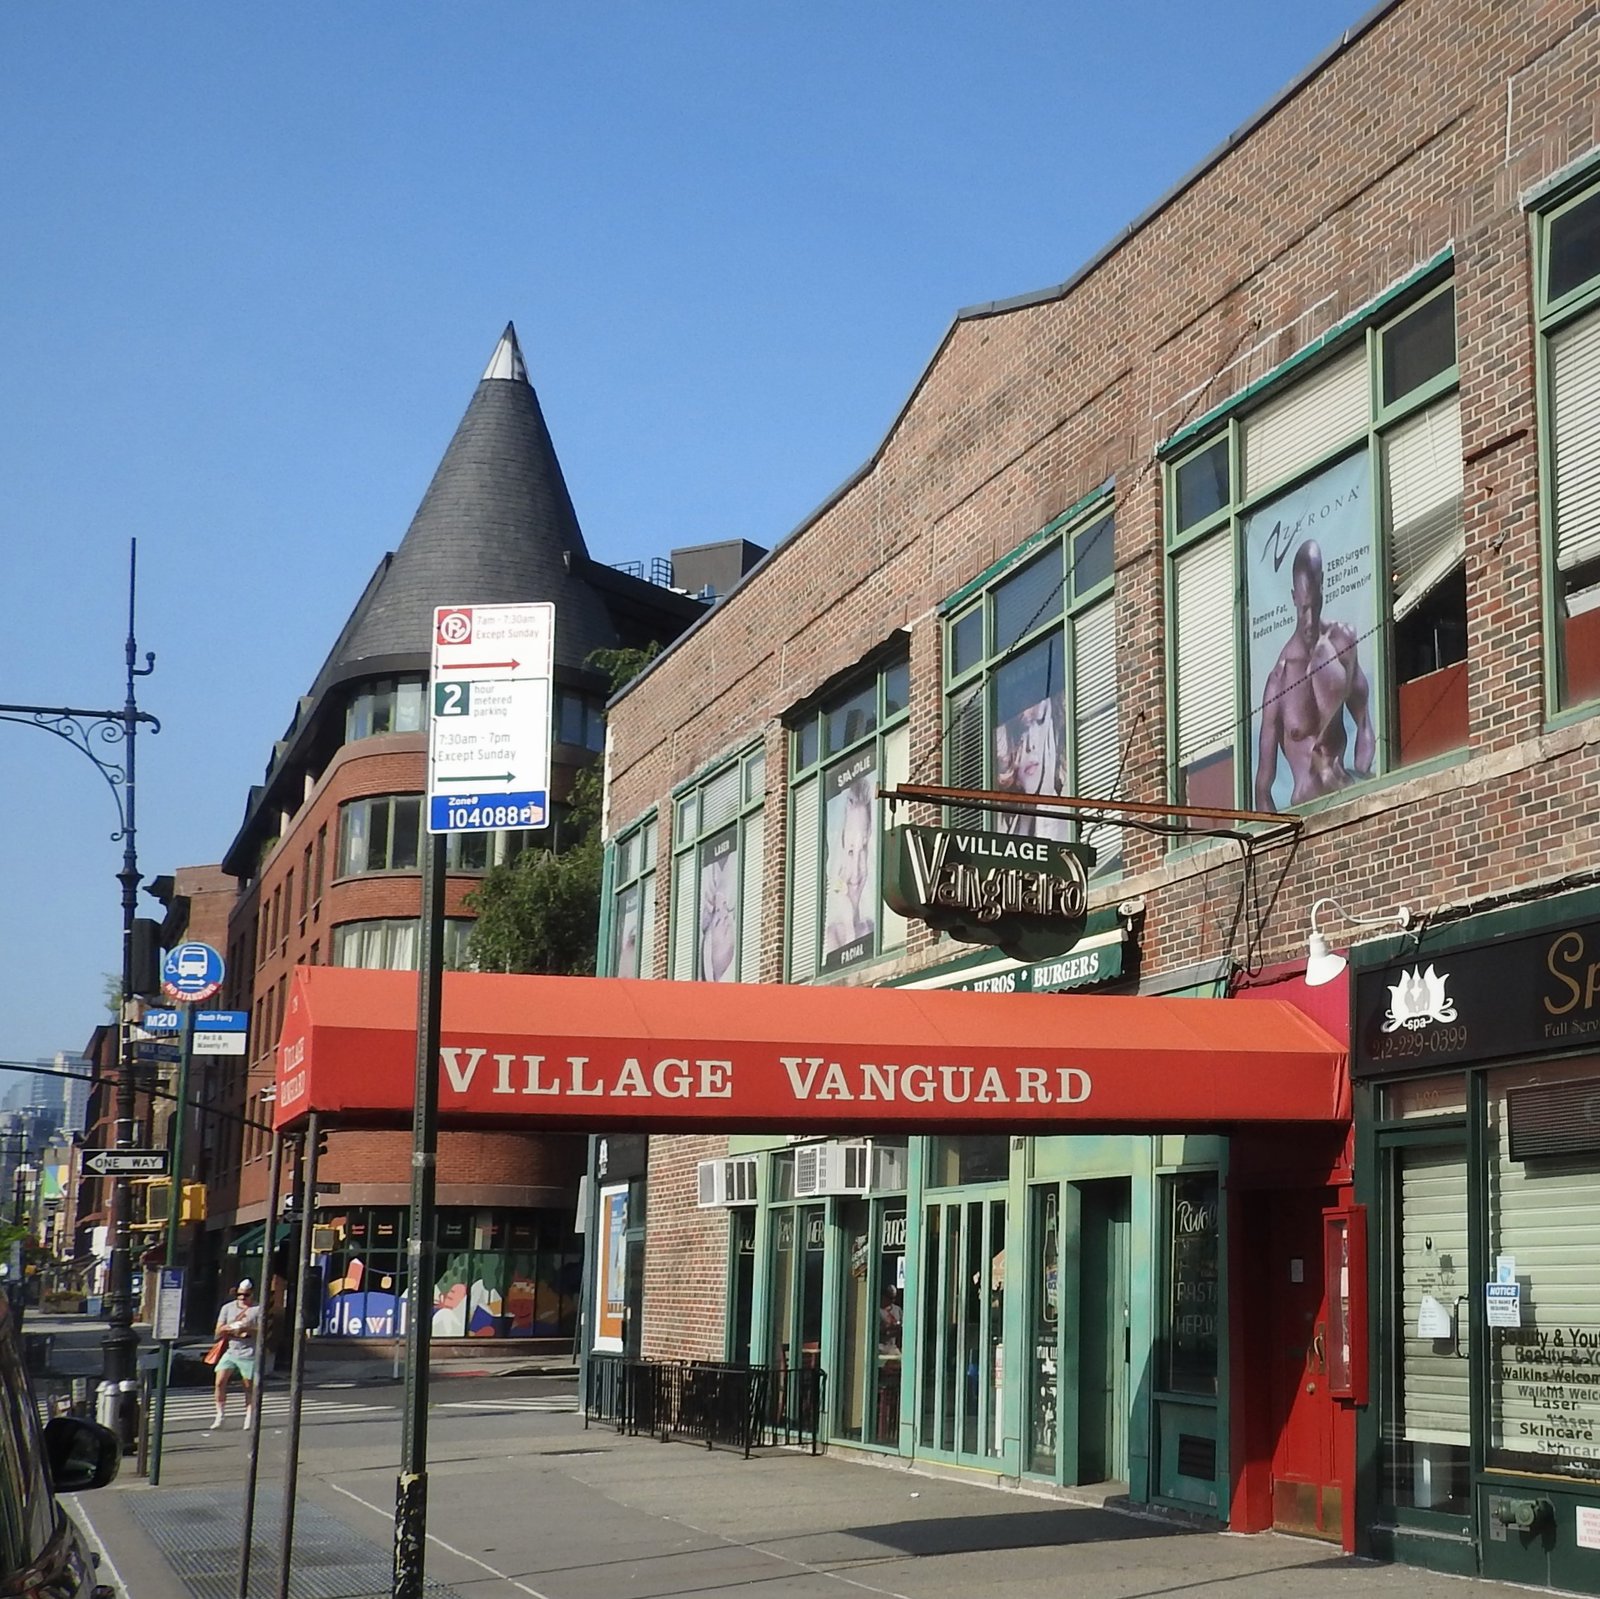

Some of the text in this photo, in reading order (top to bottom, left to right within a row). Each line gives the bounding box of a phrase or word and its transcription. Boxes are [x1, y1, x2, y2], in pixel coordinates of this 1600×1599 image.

[1283, 486, 1359, 540] ZERONA
[1327, 544, 1370, 572] ZERO Surgery
[1326, 564, 1358, 588] ZERO Pain
[1325, 588, 1340, 604] ZERO
[477, 615, 495, 625] 7am
[503, 614, 535, 624] 7:30am
[1252, 609, 1275, 627] Remove
[476, 628, 540, 640] Except Sunday
[1253, 623, 1273, 640] Reduce
[474, 685, 494, 694] hour
[442, 684, 462, 715] 2
[474, 696, 513, 705] metered
[473, 707, 508, 718] parking
[439, 733, 478, 746] 7:30am
[489, 732, 511, 744] 7pm
[438, 748, 517, 762] Except Sunday
[837, 769, 852, 788] SPA
[448, 806, 519, 828] 104088
[714, 838, 730, 857] LASER
[956, 834, 1049, 862] VILLAGE
[905, 828, 1088, 922] Vanguard
[840, 943, 864, 964] FACIAL
[973, 952, 1099, 993] HEROS BURGERS
[166, 983, 217, 1001] NO STANDING
[147, 1013, 178, 1027] M20
[1407, 1017, 1428, 1032] spa
[1544, 1021, 1568, 1038] Full
[439, 1046, 1093, 1104] VILLAGE VANGUARD
[95, 1158, 158, 1168] ONE WAY
[1489, 1286, 1517, 1296] NOTICE
[1553, 1328, 1565, 1348] &
[1568, 1328, 1600, 1349] You
[1502, 1367, 1549, 1381] Walkins
[1533, 1396, 1579, 1411] Laser
[1519, 1422, 1593, 1441] Skincare
